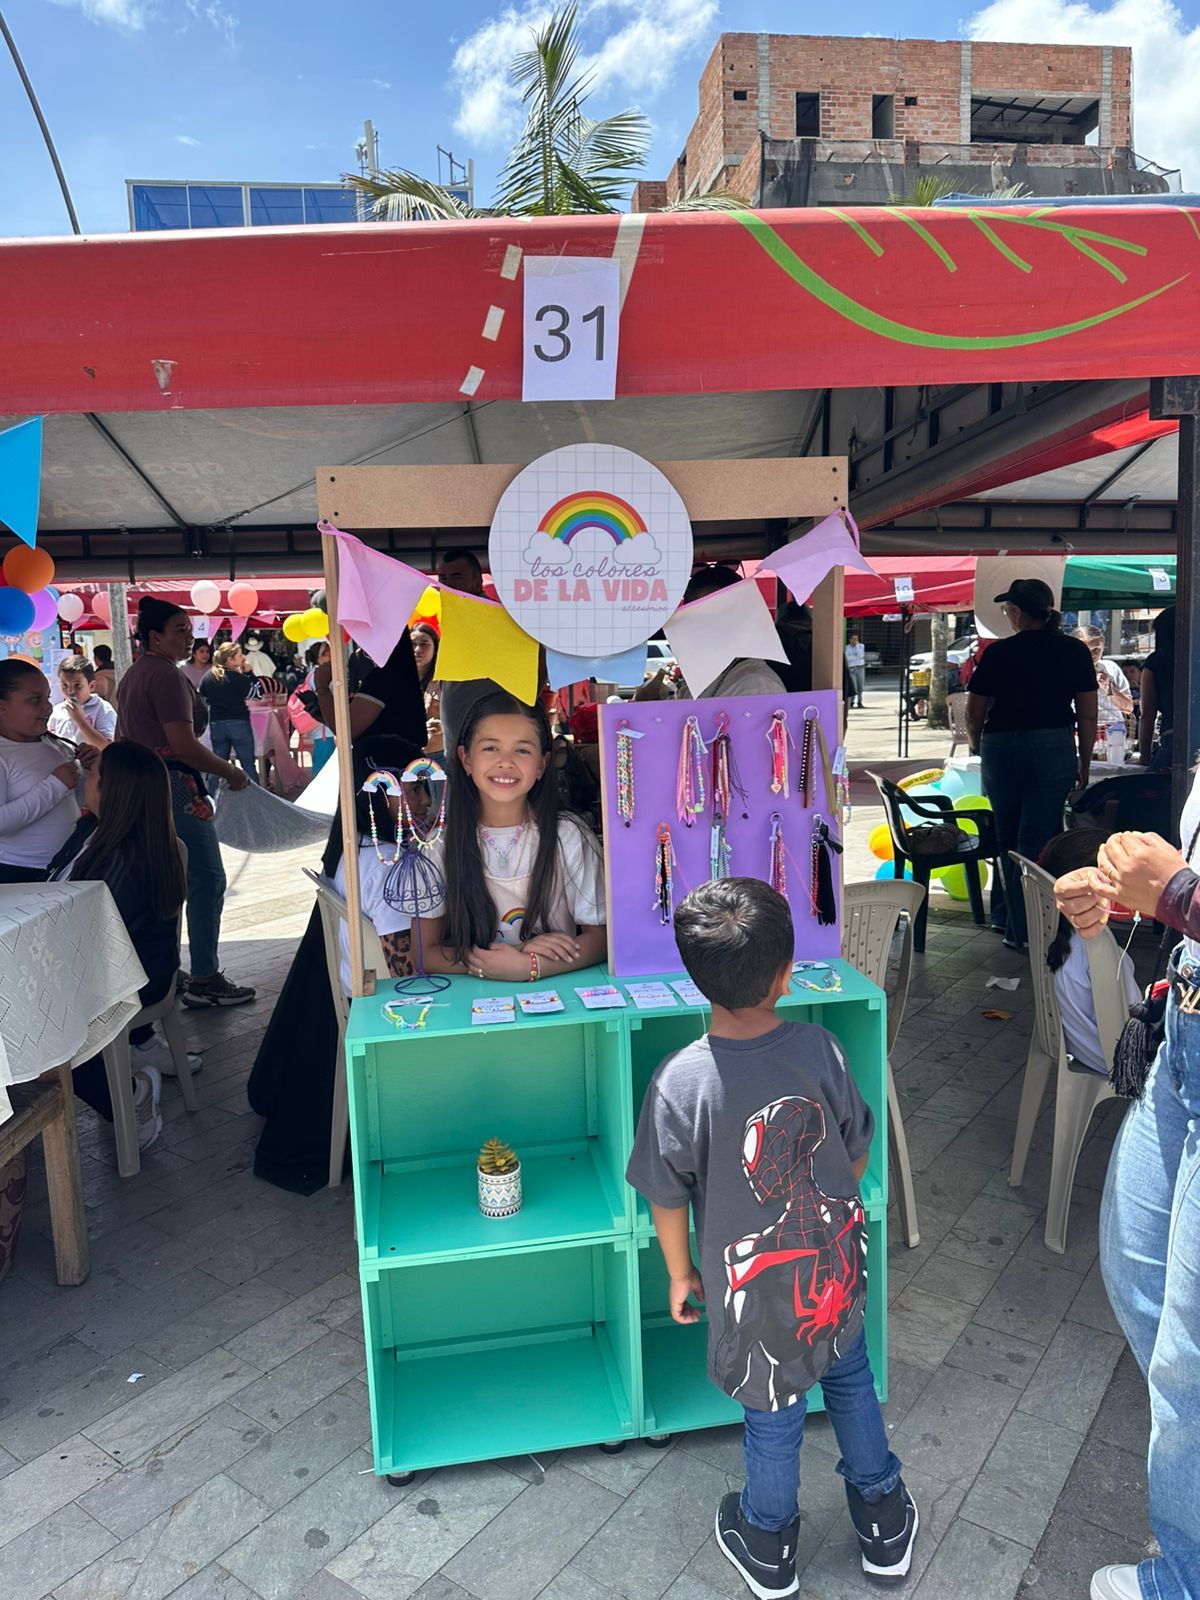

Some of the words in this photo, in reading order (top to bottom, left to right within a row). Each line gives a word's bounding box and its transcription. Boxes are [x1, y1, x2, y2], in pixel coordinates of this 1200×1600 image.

[534, 304, 605, 363] 31
[530, 556, 568, 577] los
[573, 556, 661, 578] colores
[513, 578, 549, 603] DE
[558, 578, 592, 603] LA
[602, 578, 669, 603] VIDA
[197, 622, 205, 632] 4
